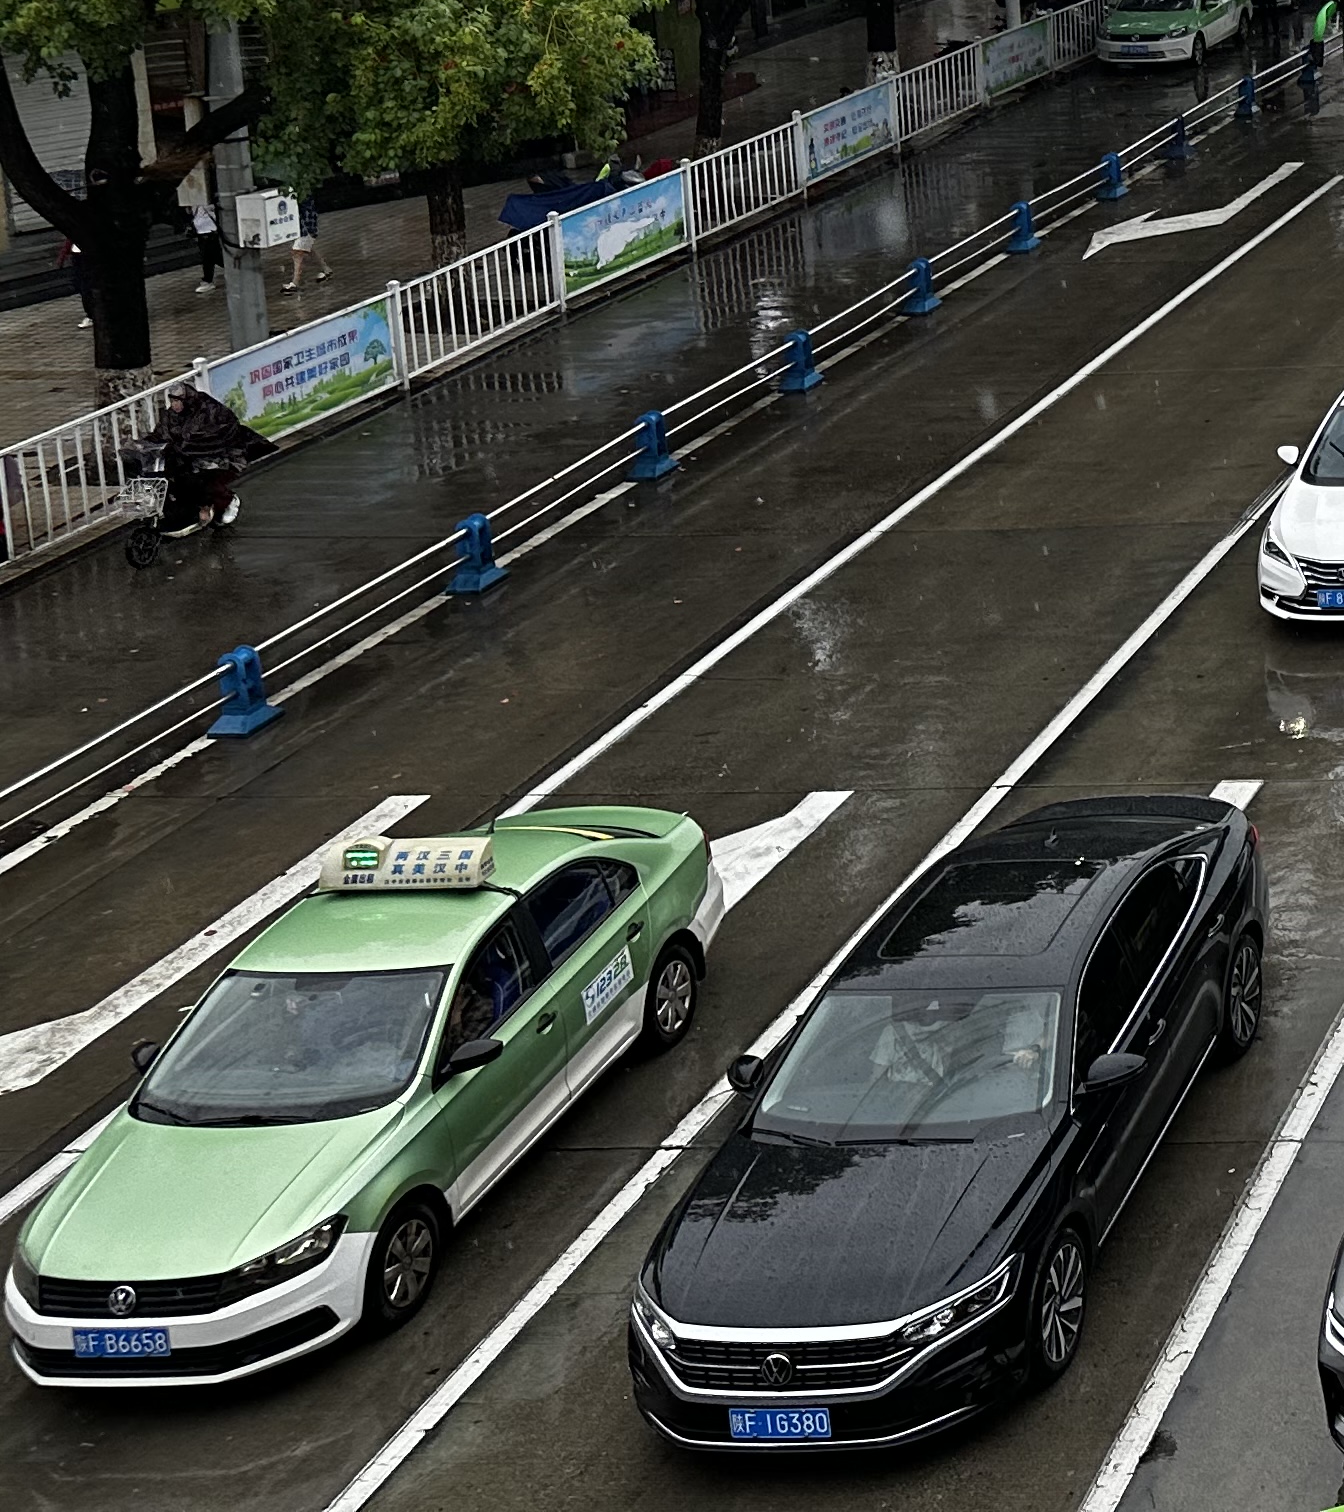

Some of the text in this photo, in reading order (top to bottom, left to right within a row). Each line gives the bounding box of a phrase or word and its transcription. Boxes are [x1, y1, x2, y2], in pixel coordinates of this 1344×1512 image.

[249, 329, 358, 384] 巩固国家卫生城市成果
[262, 352, 350, 400] 同心共建美好家园
[395, 850, 474, 861] 两汉三国
[391, 862, 469, 875] 真美汉中
[732, 1413, 828, 1434] 陕F·1G380
